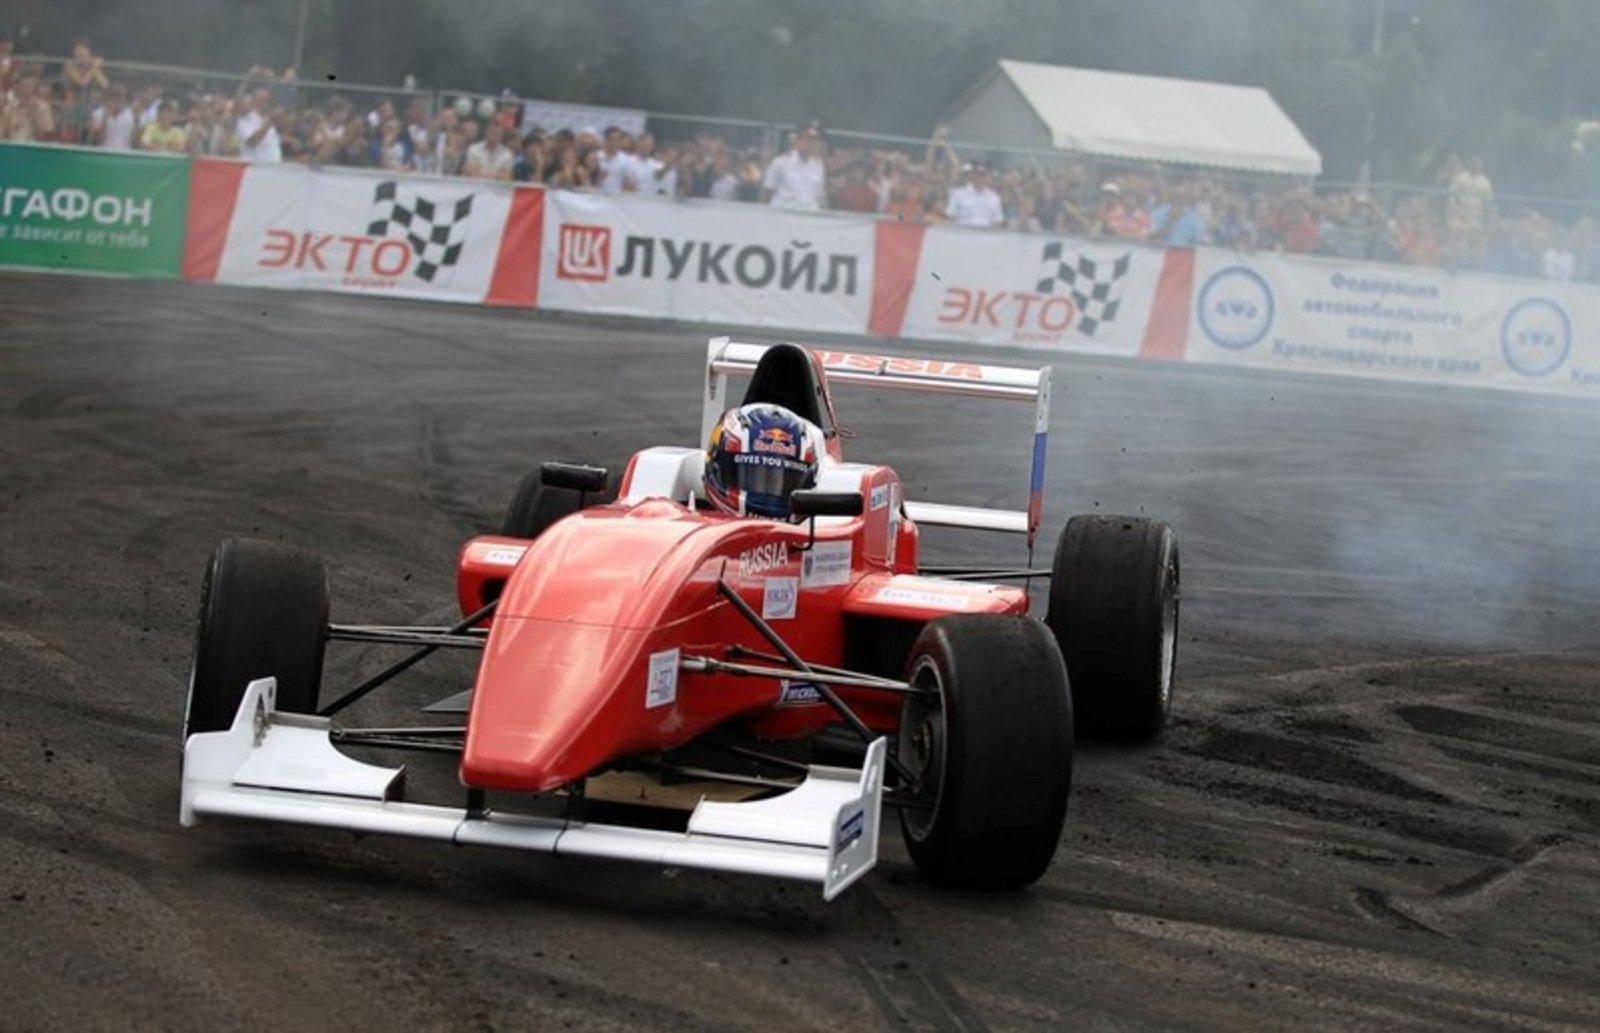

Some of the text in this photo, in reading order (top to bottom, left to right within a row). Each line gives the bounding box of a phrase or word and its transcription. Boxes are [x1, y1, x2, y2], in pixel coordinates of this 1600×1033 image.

[0, 187, 152, 226] ГАФОН
[258, 230, 411, 277] ЭКТО
[616, 236, 858, 296] ЛУКОЙЛ
[1330, 272, 1439, 298] Федерация
[937, 287, 1075, 331] ЭКТО
[819, 351, 983, 378] USSIA
[762, 455, 782, 467] YOU
[738, 540, 789, 578] RUSSIA
